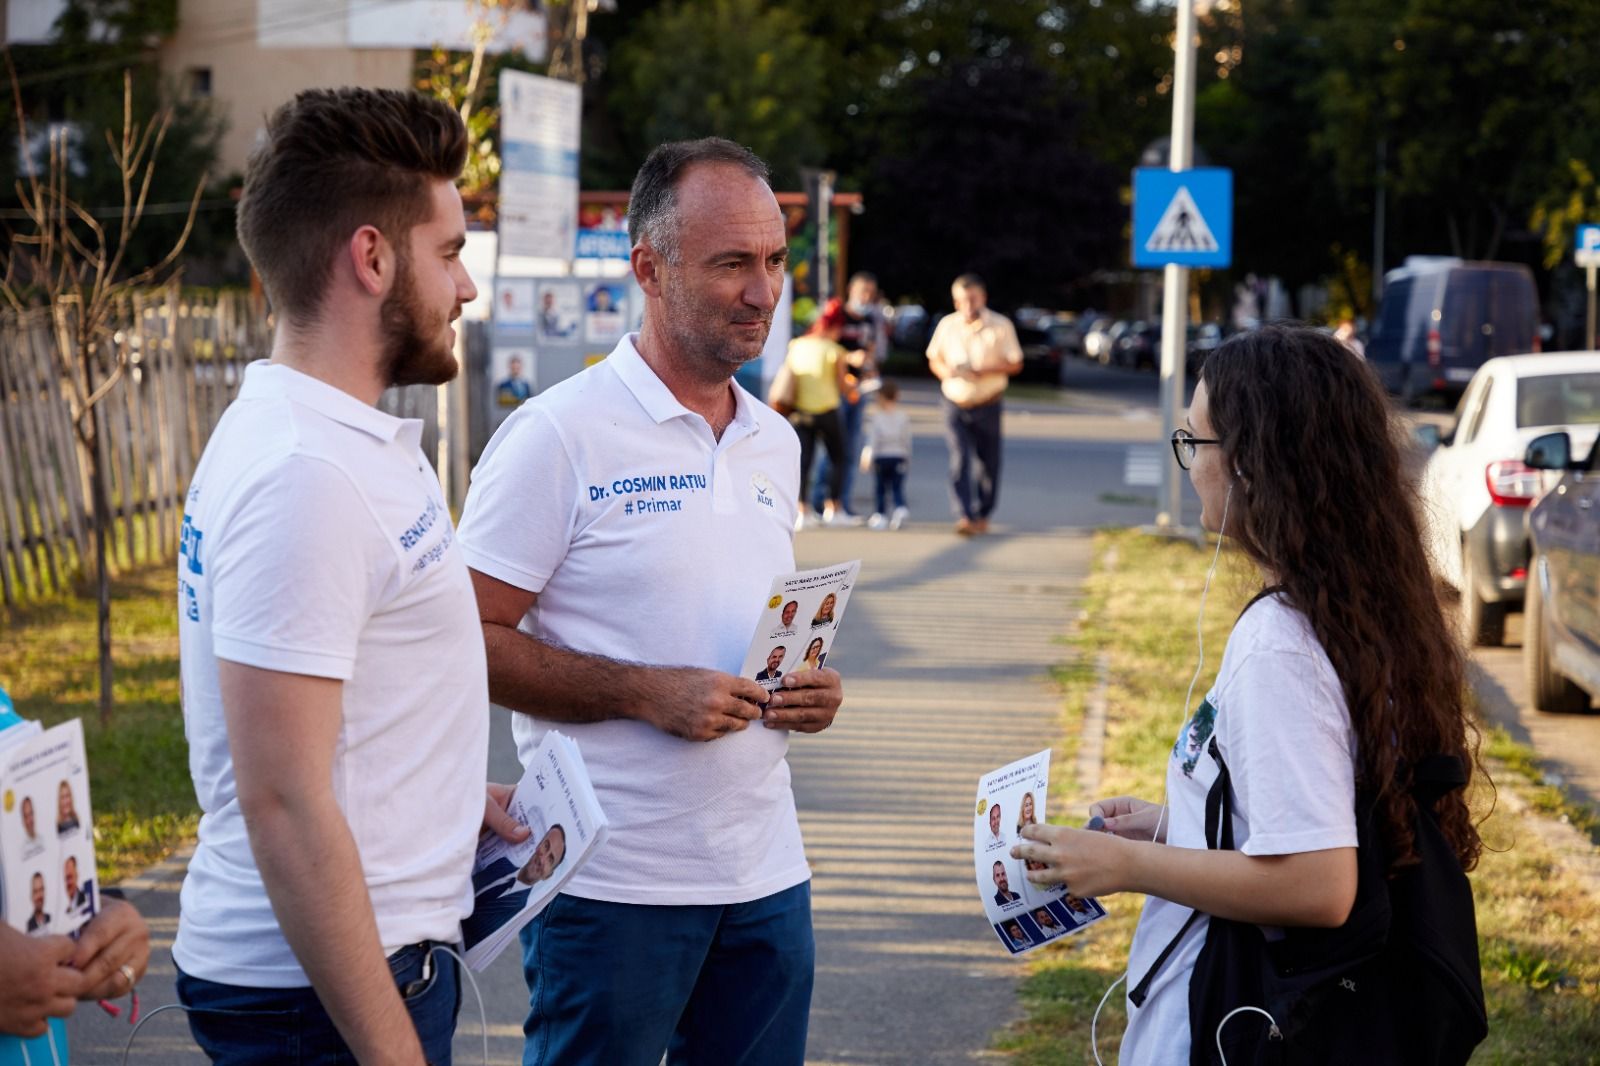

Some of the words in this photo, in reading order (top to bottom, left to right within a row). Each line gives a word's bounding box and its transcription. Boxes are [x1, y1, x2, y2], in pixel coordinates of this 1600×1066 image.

[589, 485, 610, 502] Dr.
[612, 475, 667, 495] COSMIN
[669, 474, 707, 493] RAȚIU
